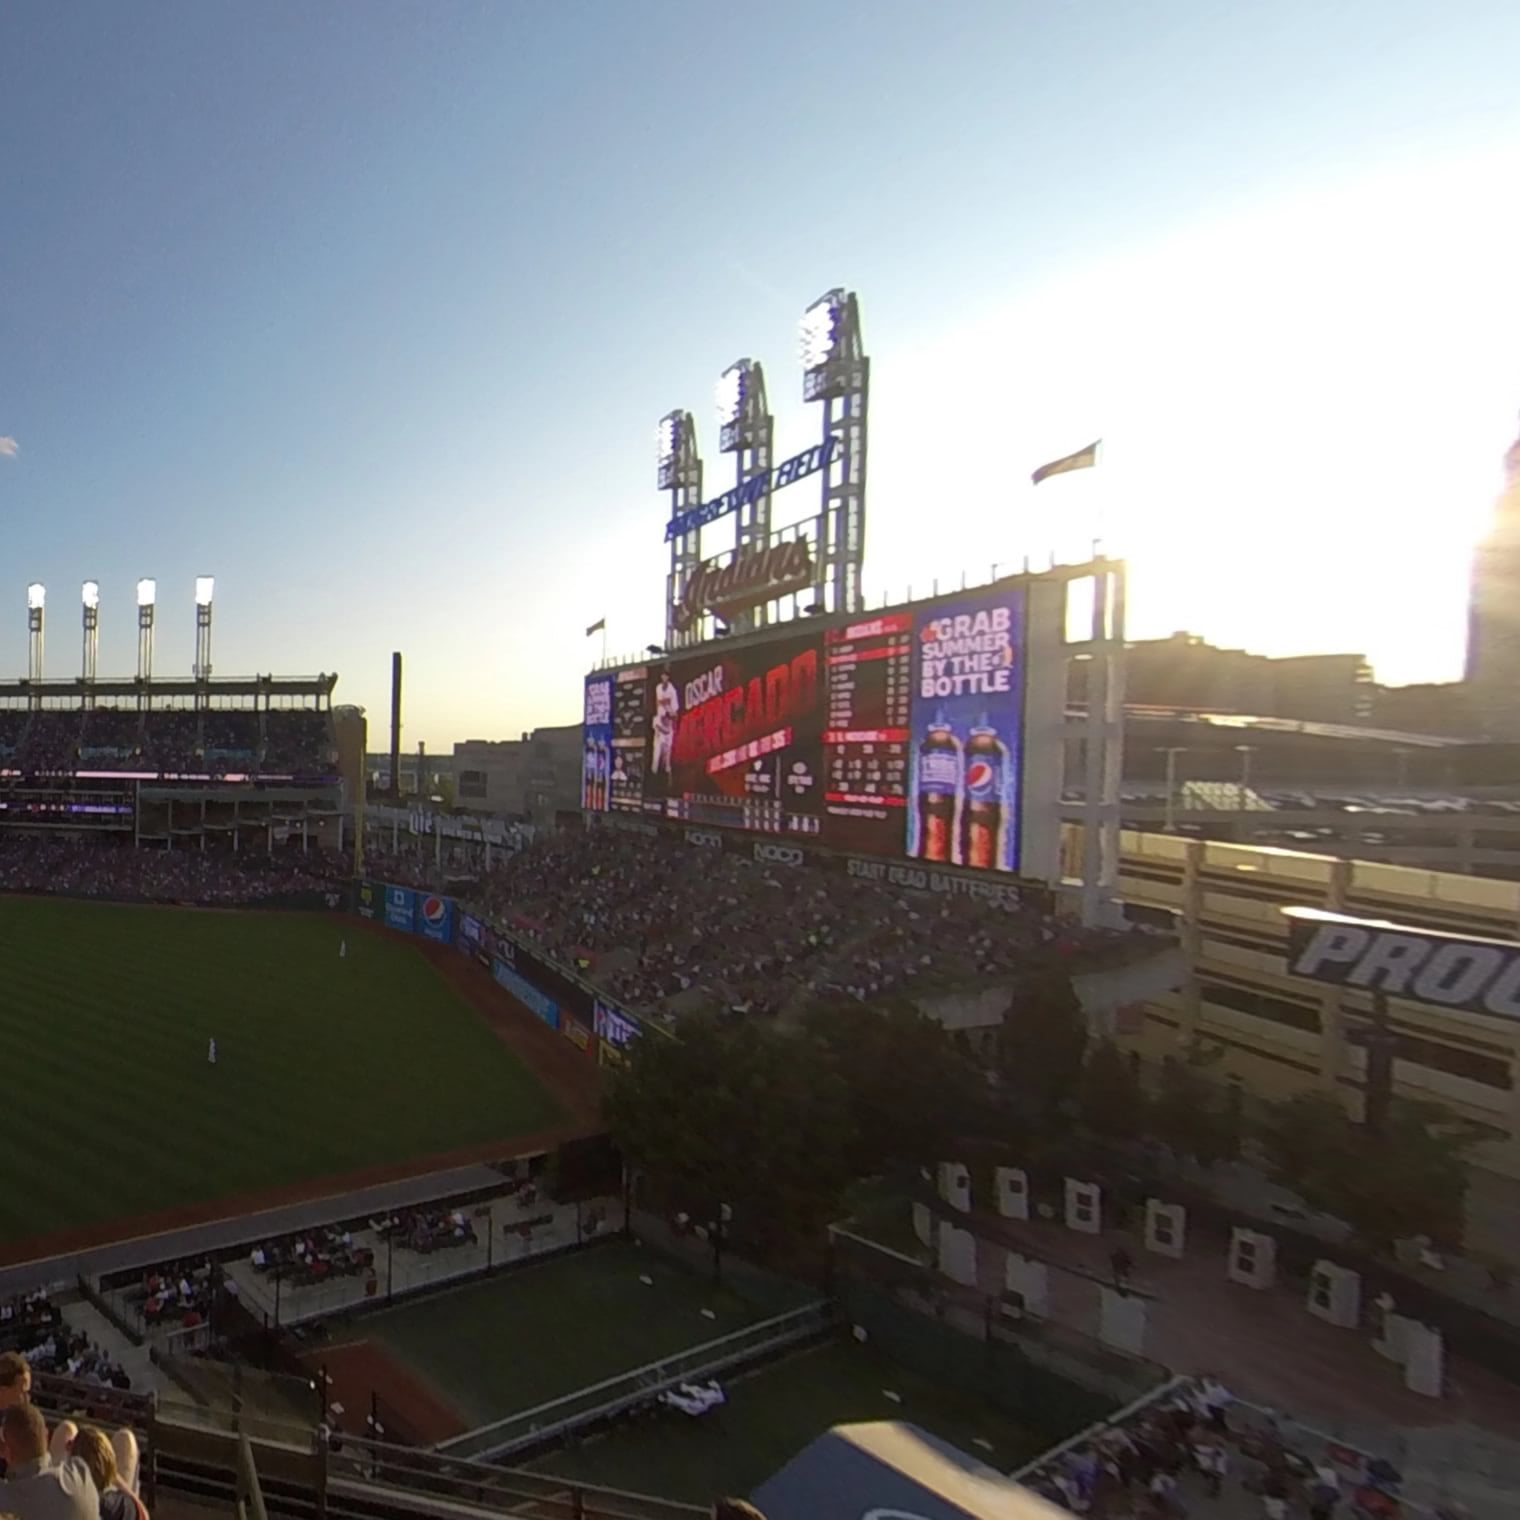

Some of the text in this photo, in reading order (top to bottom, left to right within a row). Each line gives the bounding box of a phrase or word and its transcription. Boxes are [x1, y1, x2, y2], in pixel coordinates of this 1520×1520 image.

[934, 607, 1011, 640] GRAB
[921, 632, 1011, 660] SUMMER
[922, 652, 993, 678] BY THE
[684, 665, 723, 710] OSCAR
[921, 669, 1011, 698] BOTTLE
[846, 858, 1021, 903] START DEAD BATTERIES
